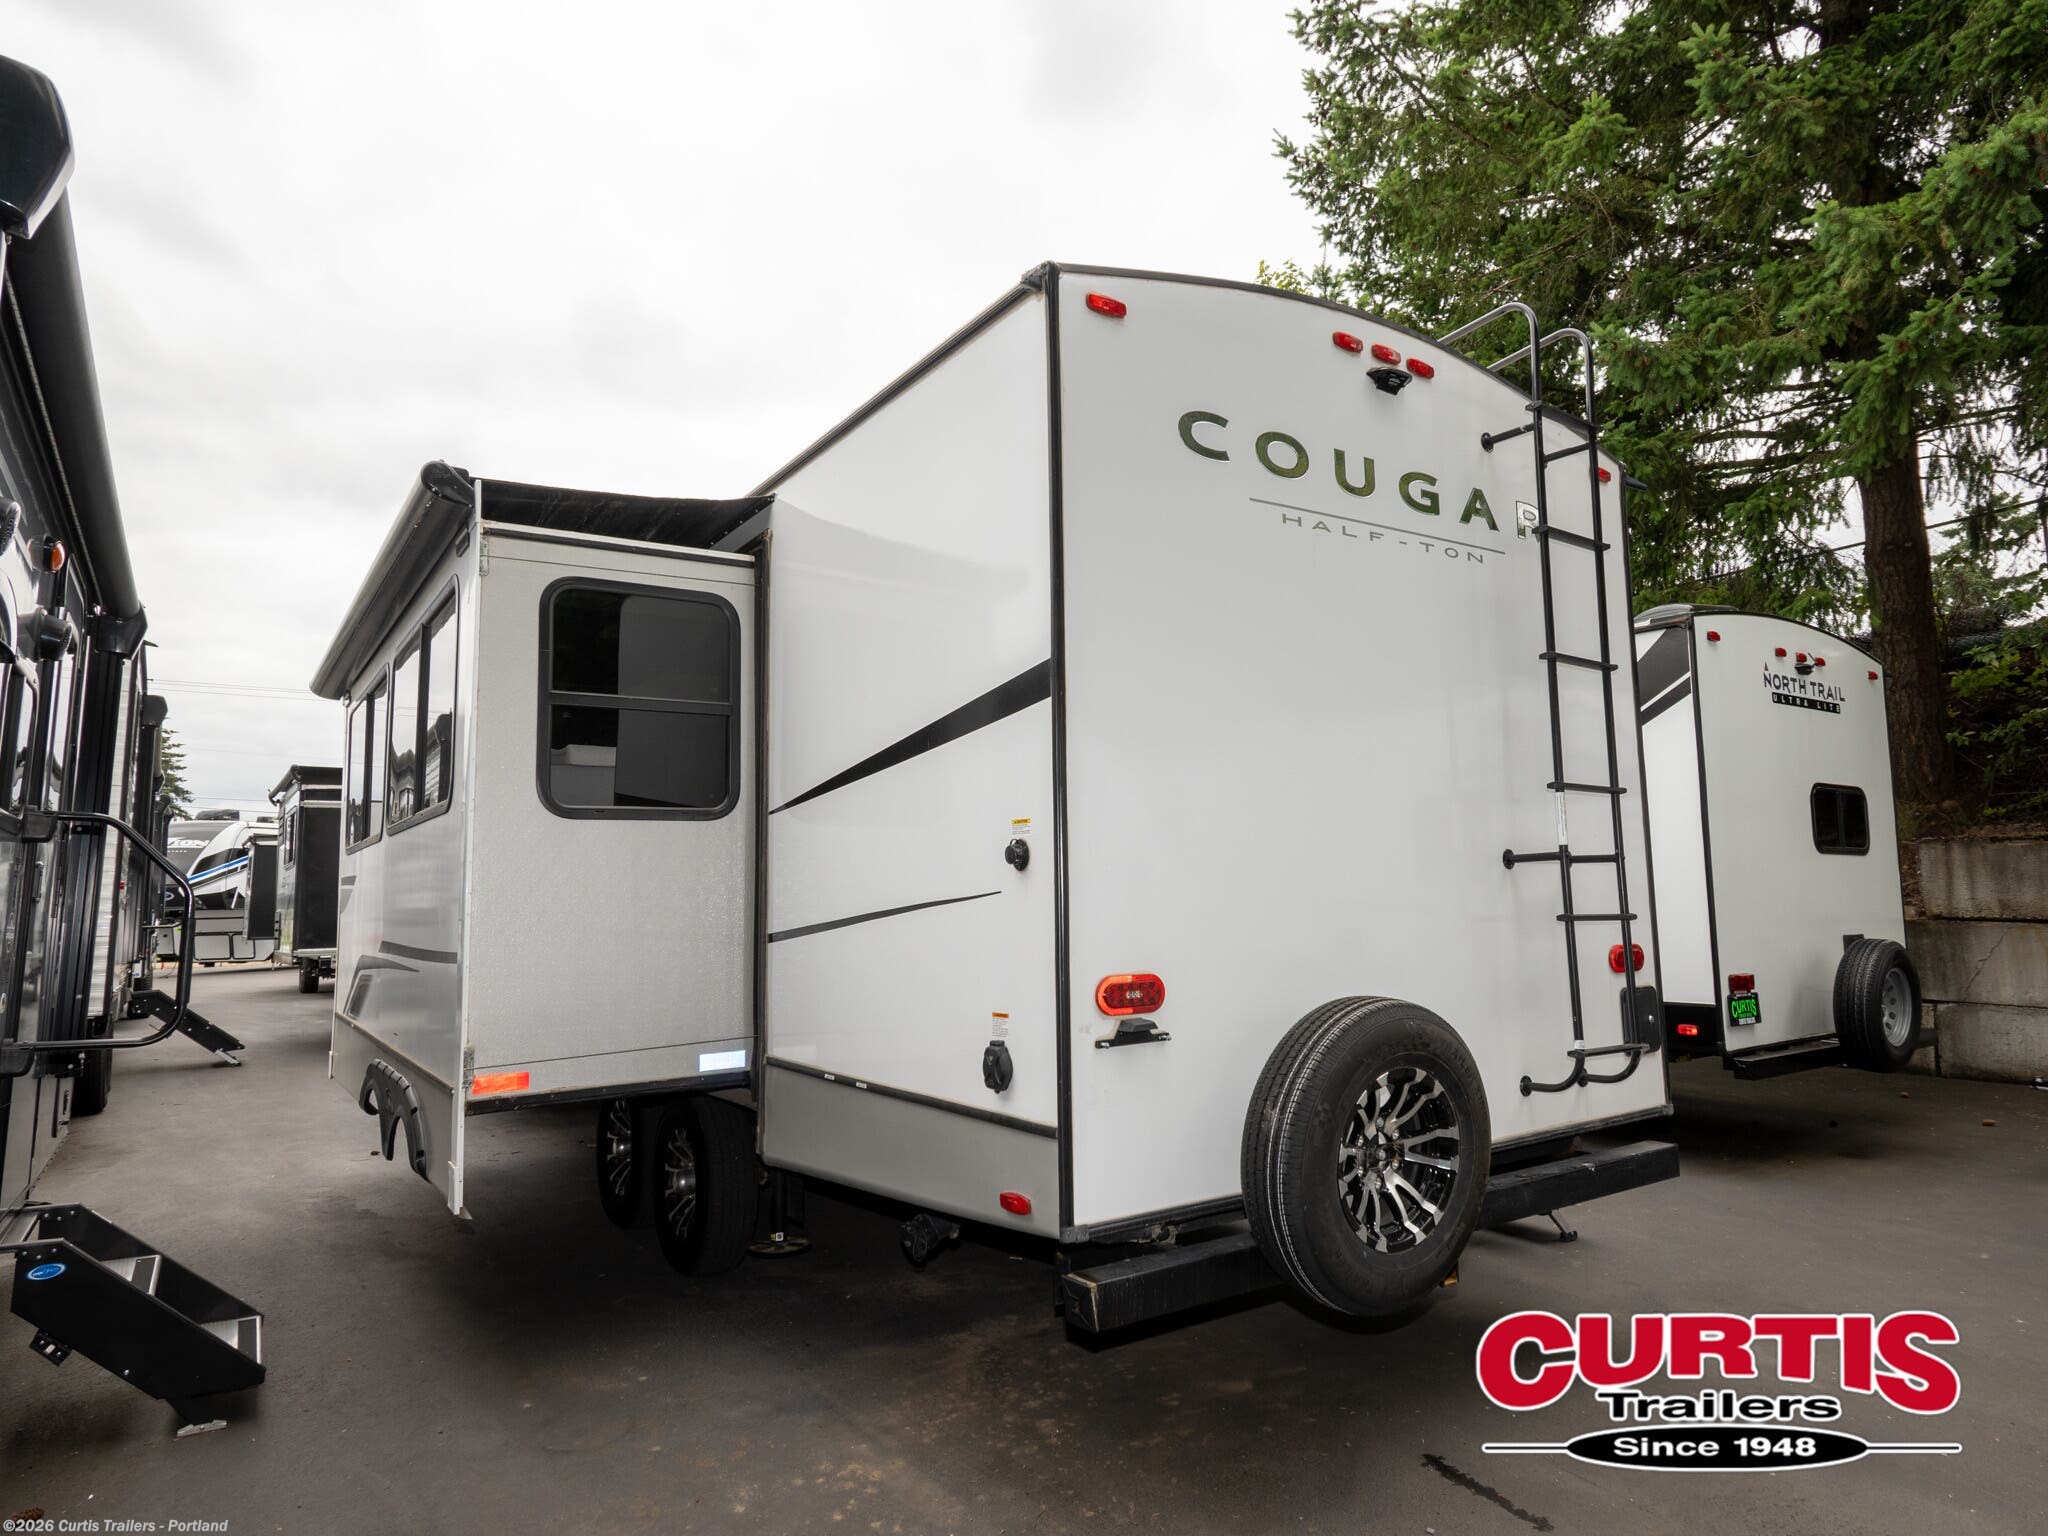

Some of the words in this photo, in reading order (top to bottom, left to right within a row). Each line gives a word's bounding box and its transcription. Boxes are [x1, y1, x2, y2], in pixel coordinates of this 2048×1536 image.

[1178, 410, 1541, 543] COUGAR
[1282, 513, 1484, 564] HALF-TON
[1763, 672, 1807, 695] NORTH
[1810, 681, 1846, 702] TRAIL
[1772, 693, 1809, 707] ULTRA
[1817, 701, 1840, 713] LITE
[1731, 999, 1757, 1018] CURTIS
